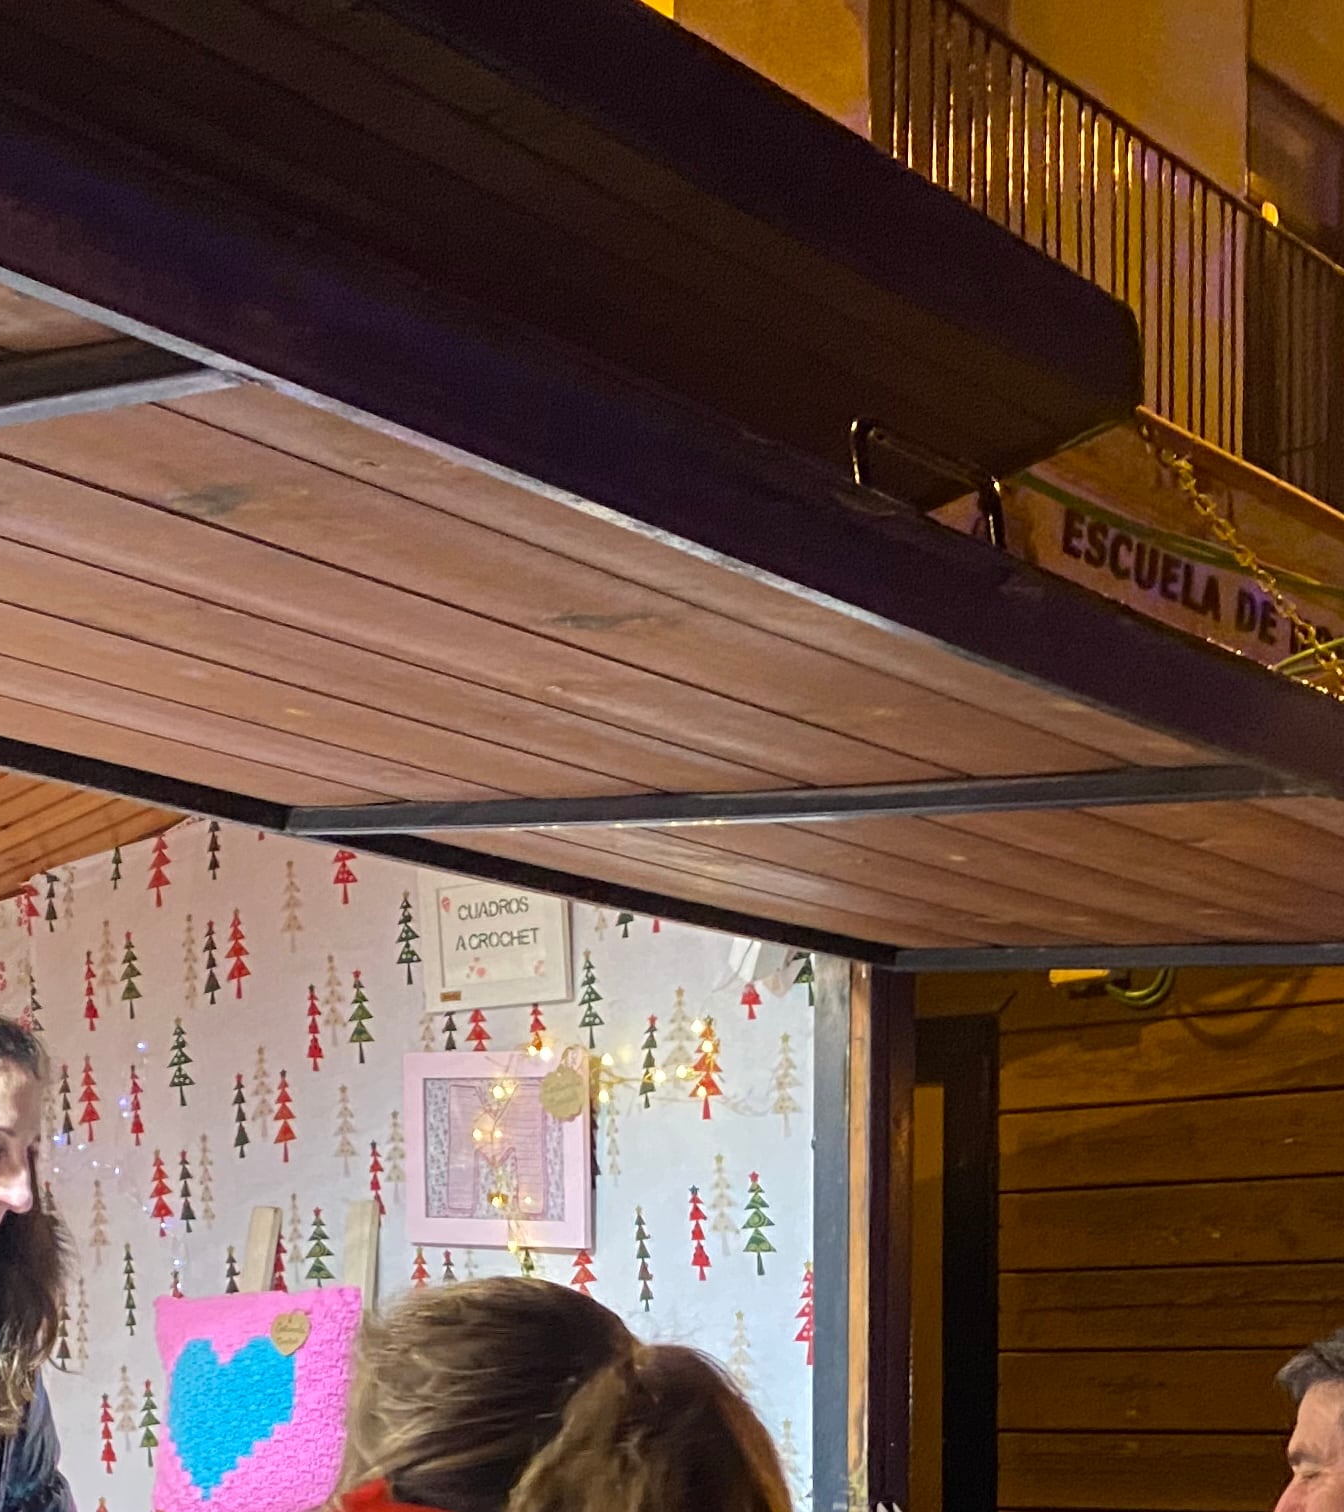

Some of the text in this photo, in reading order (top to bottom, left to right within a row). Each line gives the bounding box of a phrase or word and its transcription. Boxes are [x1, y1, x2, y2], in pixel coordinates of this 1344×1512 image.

[1062, 508, 1222, 623] ESCUELA
[1235, 587, 1279, 646] DE
[457, 896, 529, 920] CUADROS
[456, 927, 540, 951] A CROCHET
